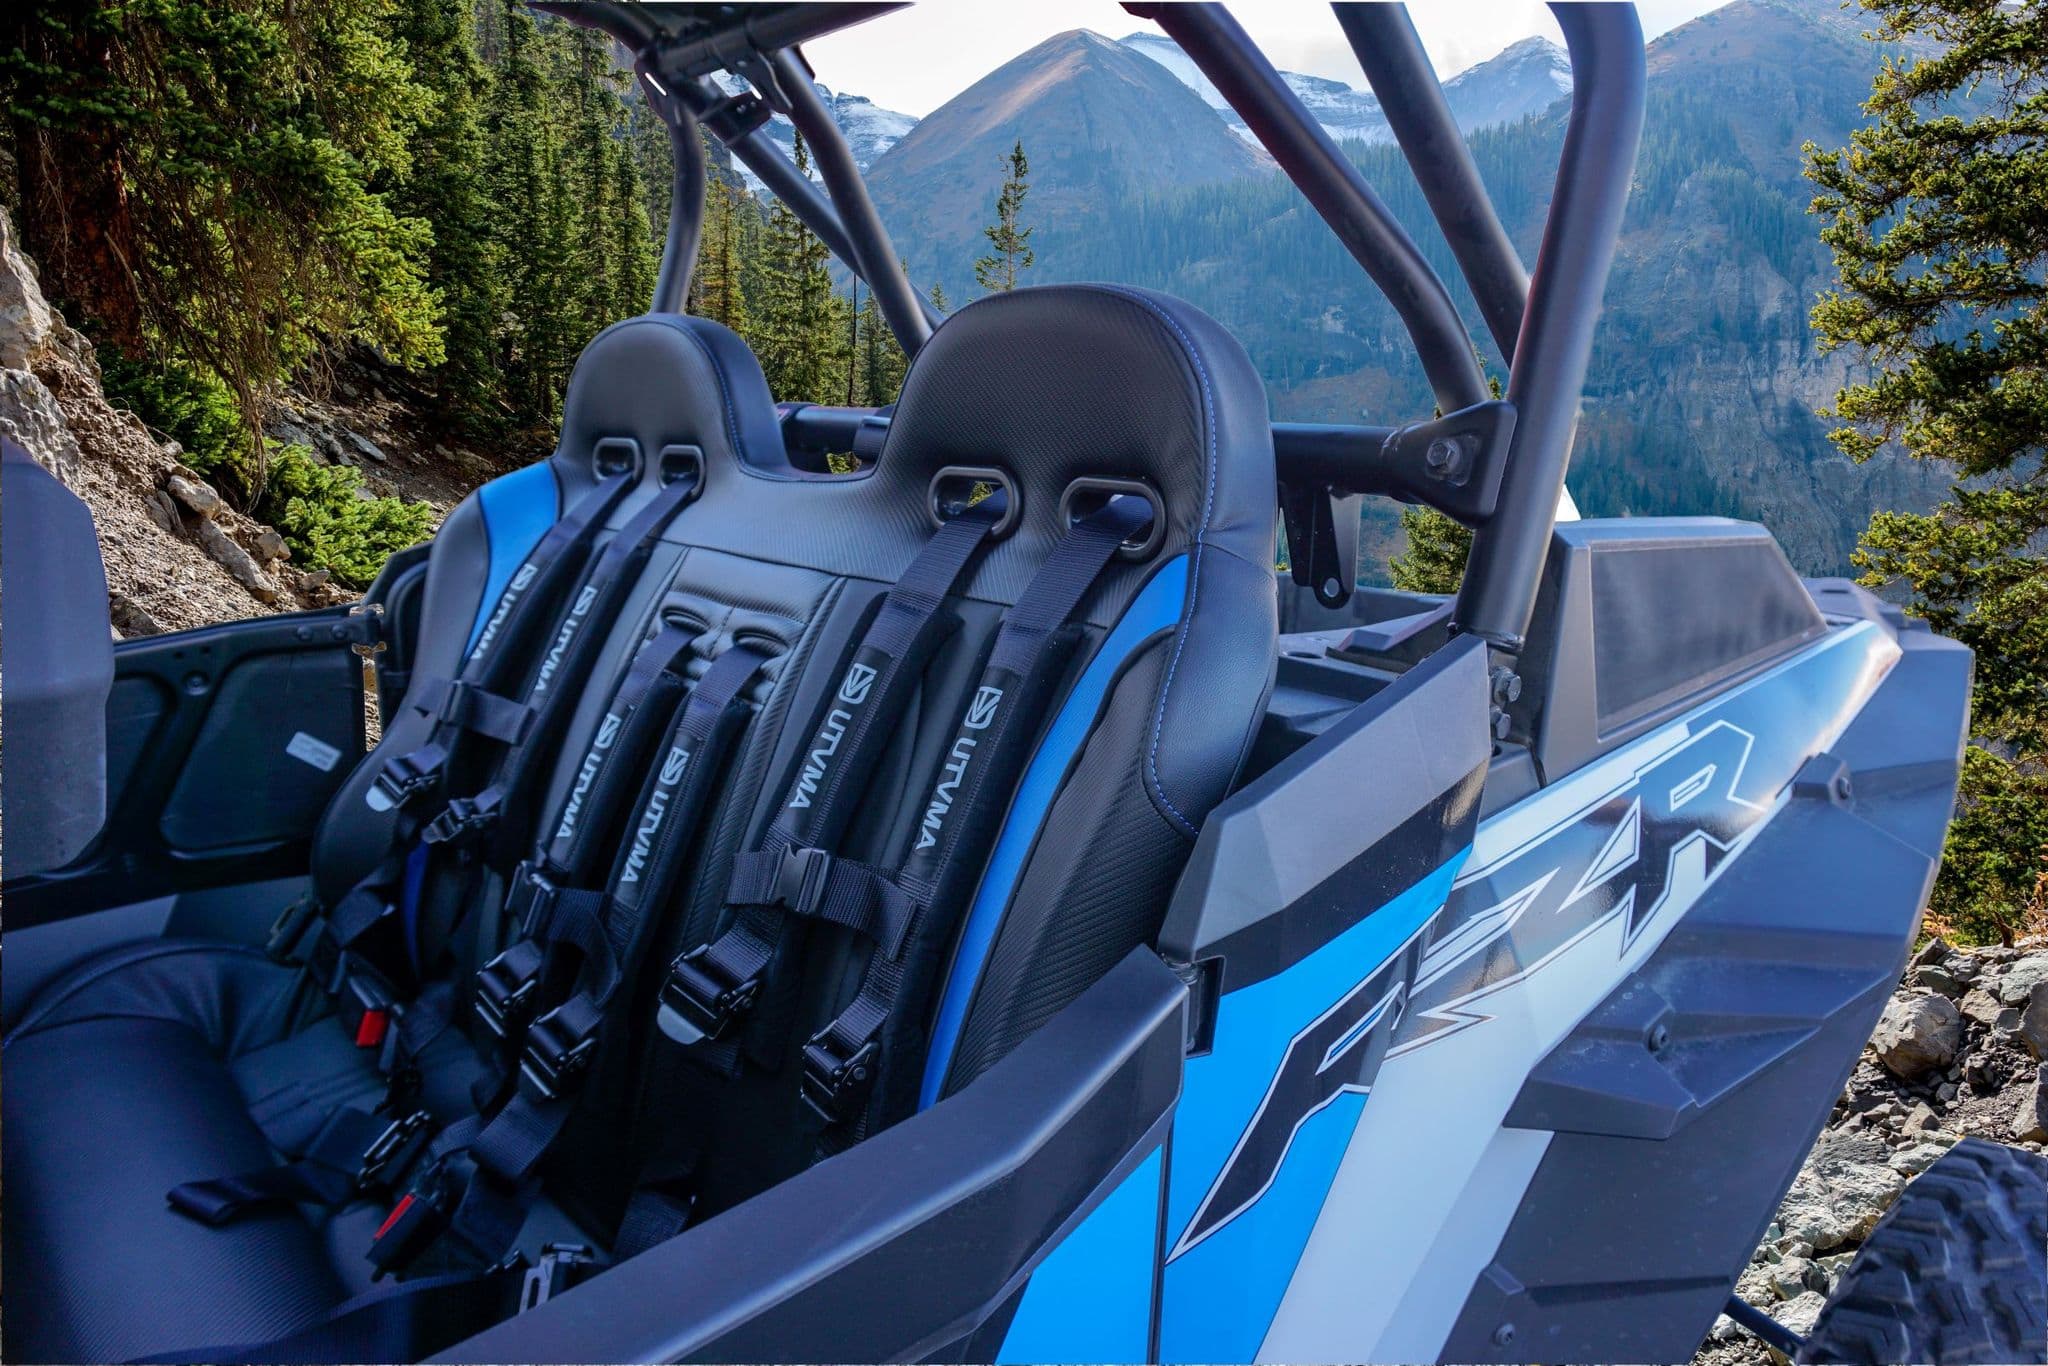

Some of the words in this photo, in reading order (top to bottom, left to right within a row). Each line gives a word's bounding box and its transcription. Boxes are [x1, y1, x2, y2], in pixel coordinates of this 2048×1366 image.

[534, 618, 578, 691] UTVMA
[556, 751, 603, 838] UTVMA
[789, 709, 852, 808] UTVMA
[915, 737, 978, 850] UTVMA
[621, 793, 669, 882] UTVMA
